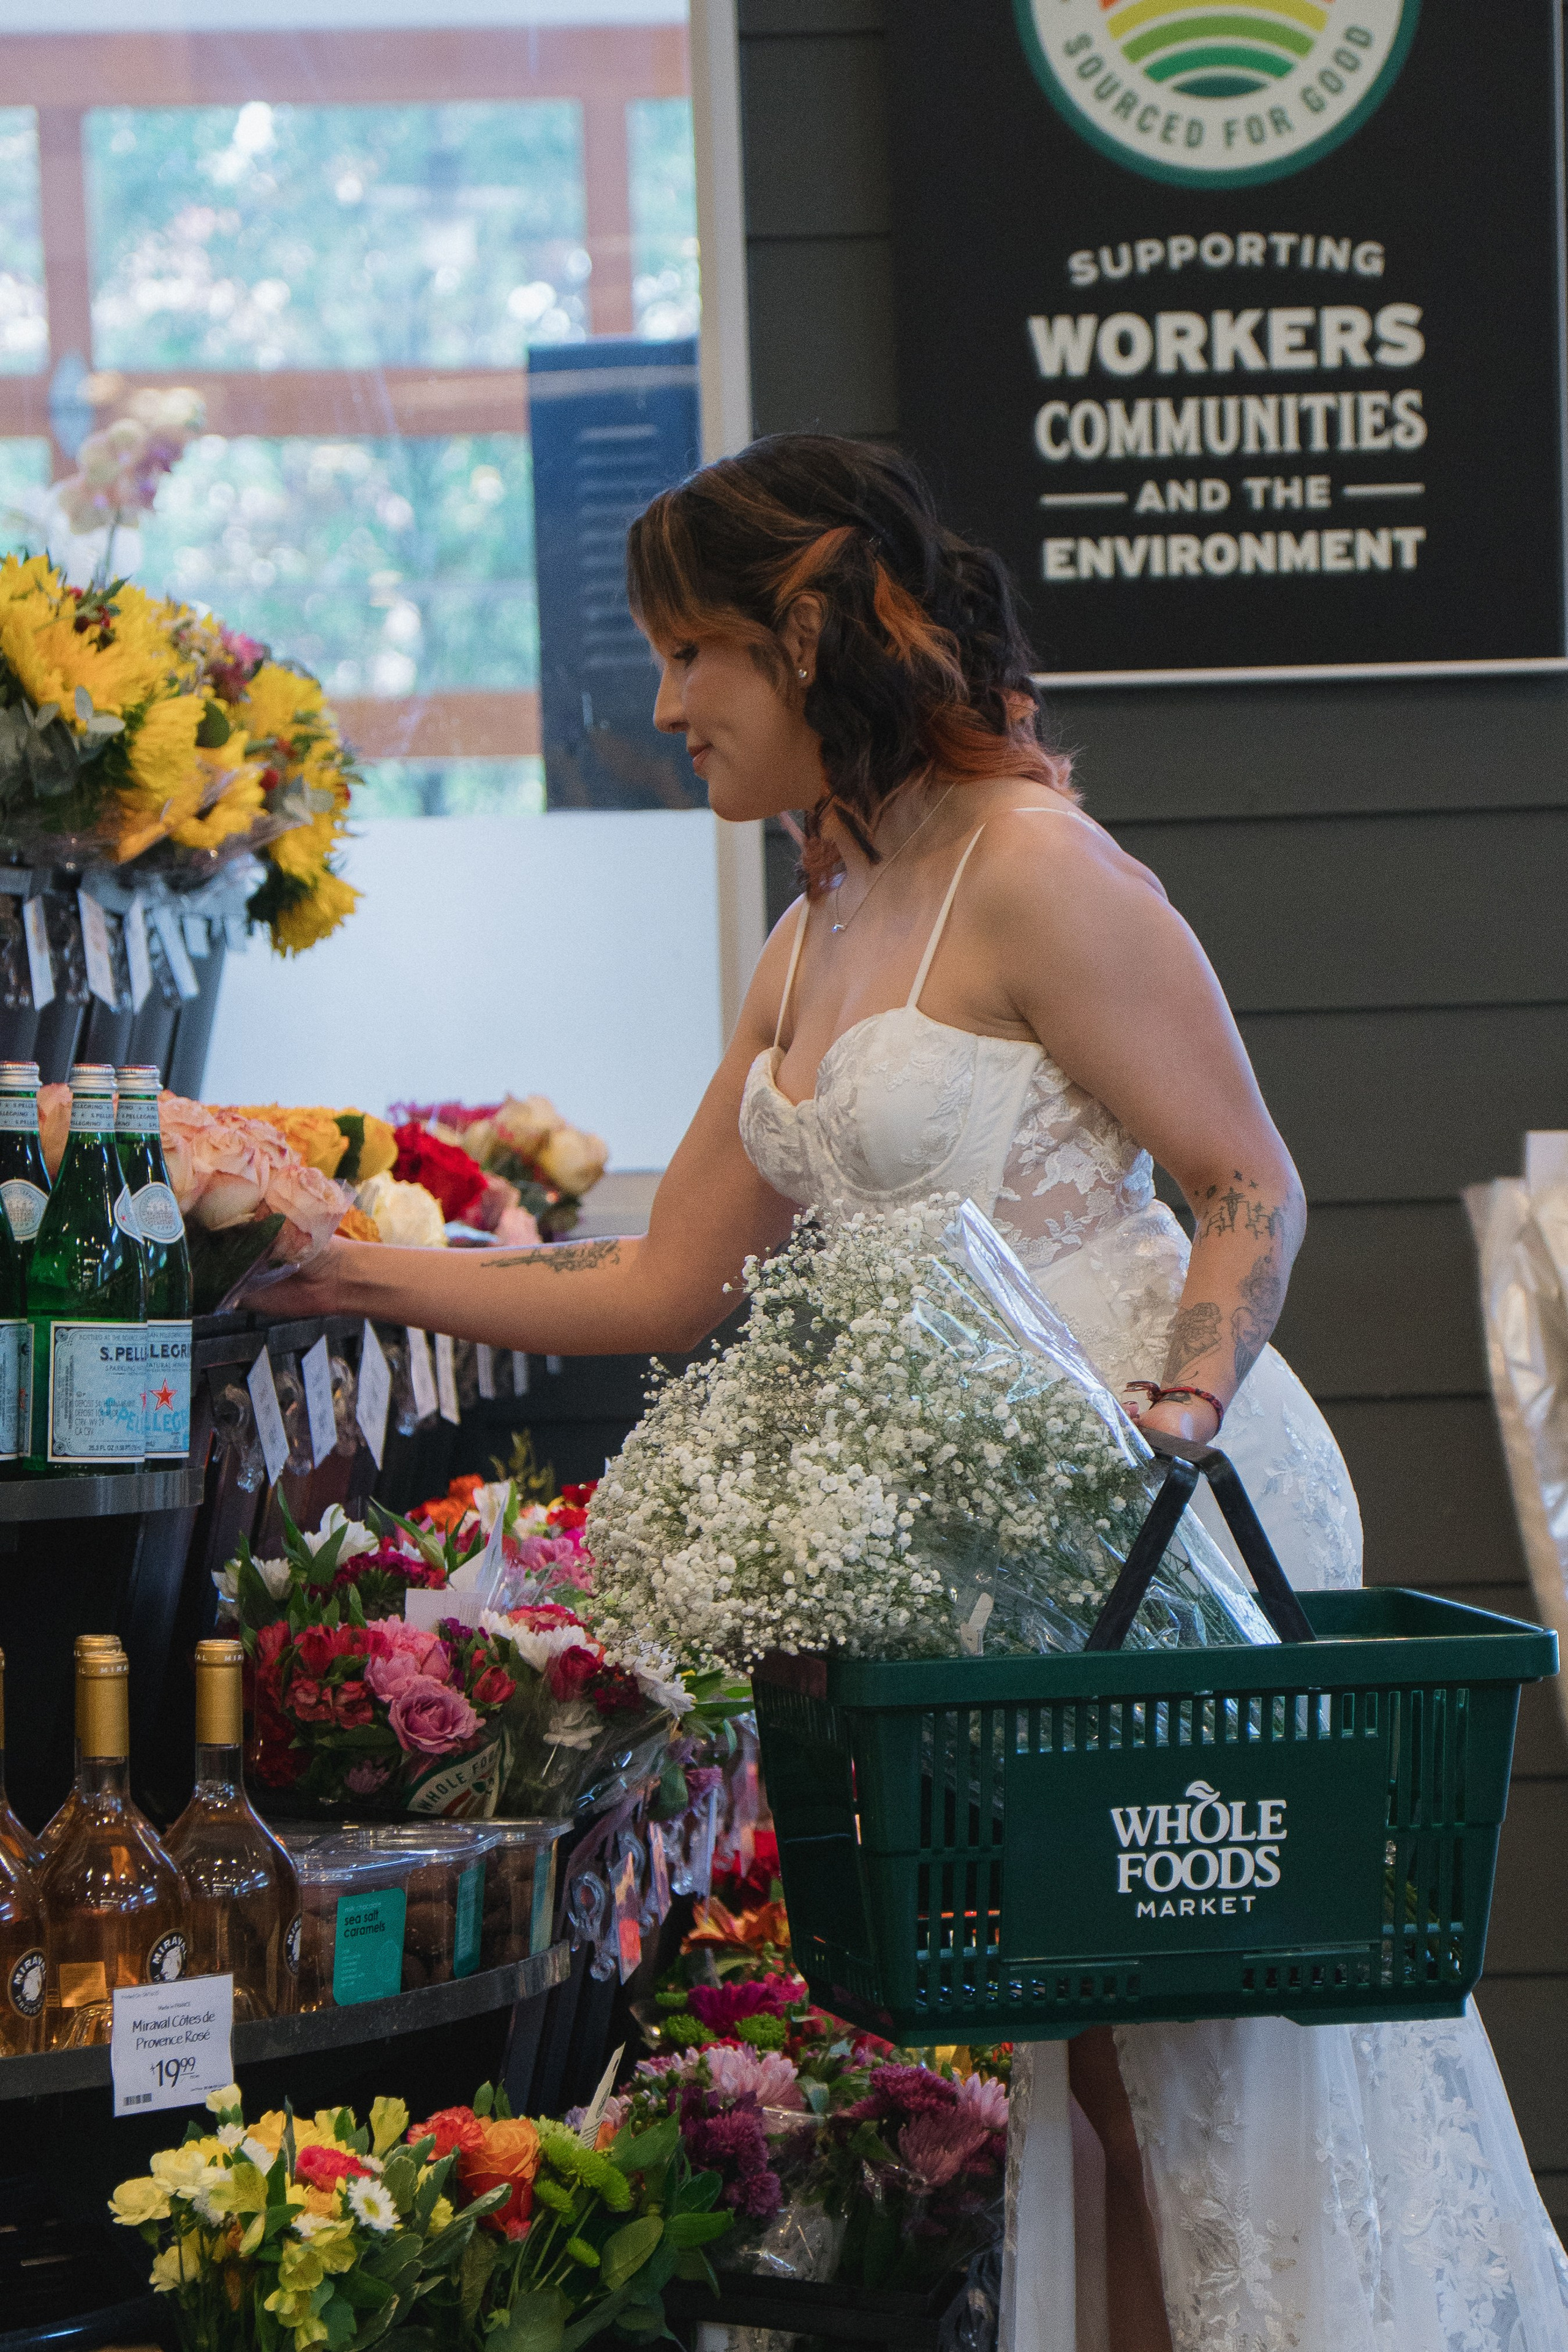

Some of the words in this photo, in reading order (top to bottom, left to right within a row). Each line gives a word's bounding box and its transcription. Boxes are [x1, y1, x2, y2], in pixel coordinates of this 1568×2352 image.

[1063, 32, 1205, 149] SOURCED
[1222, 106, 1294, 149] FOR
[1300, 25, 1374, 115] GOOD
[1068, 232, 1386, 287] SUPPORTING
[1028, 303, 1426, 378] WORKERS
[1035, 390, 1428, 460] COMMUNITIES
[1135, 480, 1231, 513] AND
[1243, 475, 1332, 508] THE
[1042, 527, 1426, 580] ENVIRONMENT
[417, 1771, 467, 1811] WHOLE
[1110, 1792, 1287, 1847] WHOLE
[1117, 1845, 1281, 1893] FOODS
[344, 1915, 361, 1926] sea
[364, 1909, 379, 1923] salt
[1136, 1896, 1256, 1918] MARKET
[344, 1921, 385, 1939] caramels
[132, 2016, 170, 2033] Miraval
[172, 2015, 201, 2028] Côtes
[202, 2011, 216, 2022] de
[136, 2035, 183, 2050] Provence
[186, 2029, 211, 2043] Rosé
